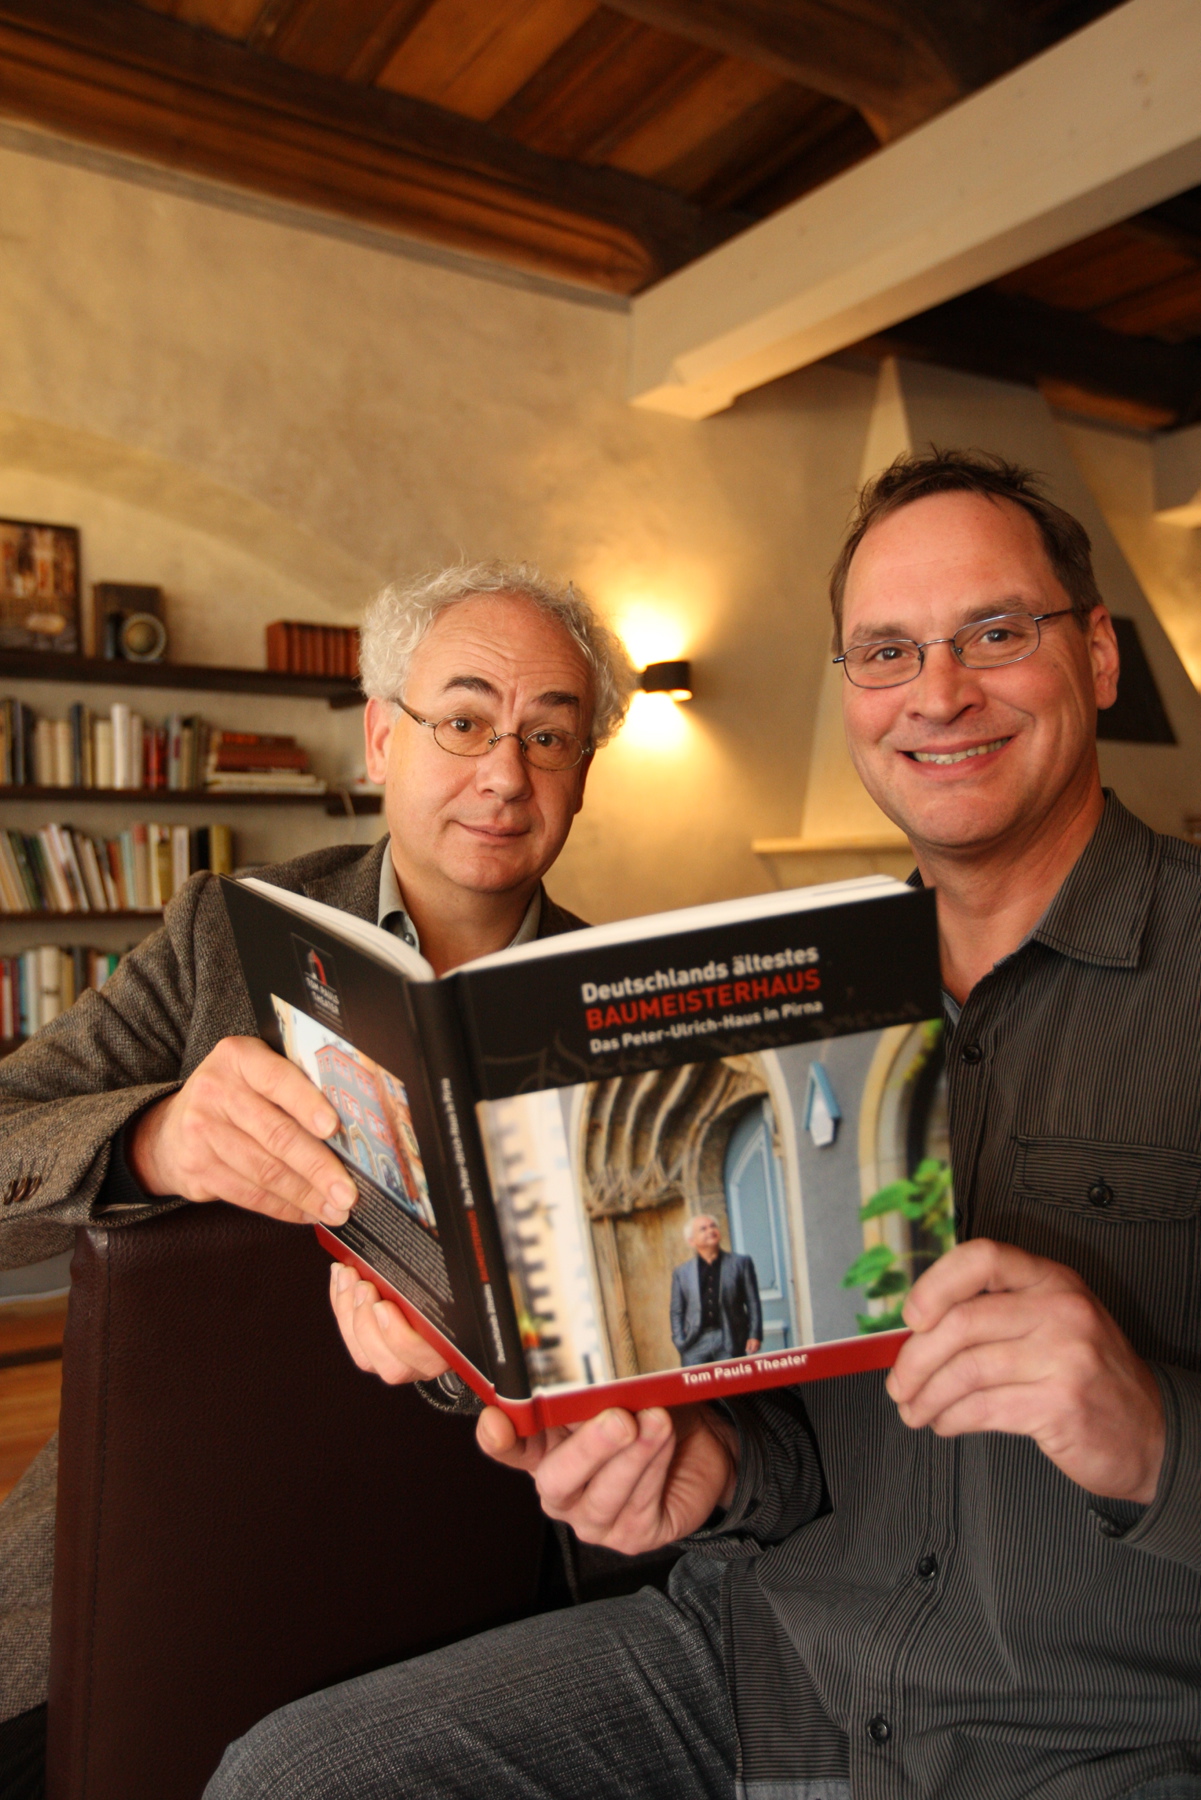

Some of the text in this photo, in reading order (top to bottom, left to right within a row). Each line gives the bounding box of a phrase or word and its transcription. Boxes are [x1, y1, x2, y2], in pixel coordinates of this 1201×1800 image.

[581, 946, 819, 1004] Deutschlands ältestes
[585, 968, 822, 1031] BAUMEISTERHAUS
[589, 1000, 823, 1055] Das Peter-Ulrich-Haus in Pirna
[440, 1078, 453, 1102] Pirna
[448, 1112, 471, 1189] Peter-Ulrich-Haus
[463, 1189, 475, 1207] Das
[466, 1210, 490, 1282] BAUMEISTERHAUS
[490, 1314, 507, 1364] Deutschlands
[681, 1353, 808, 1386] Tom Pauls Theater
